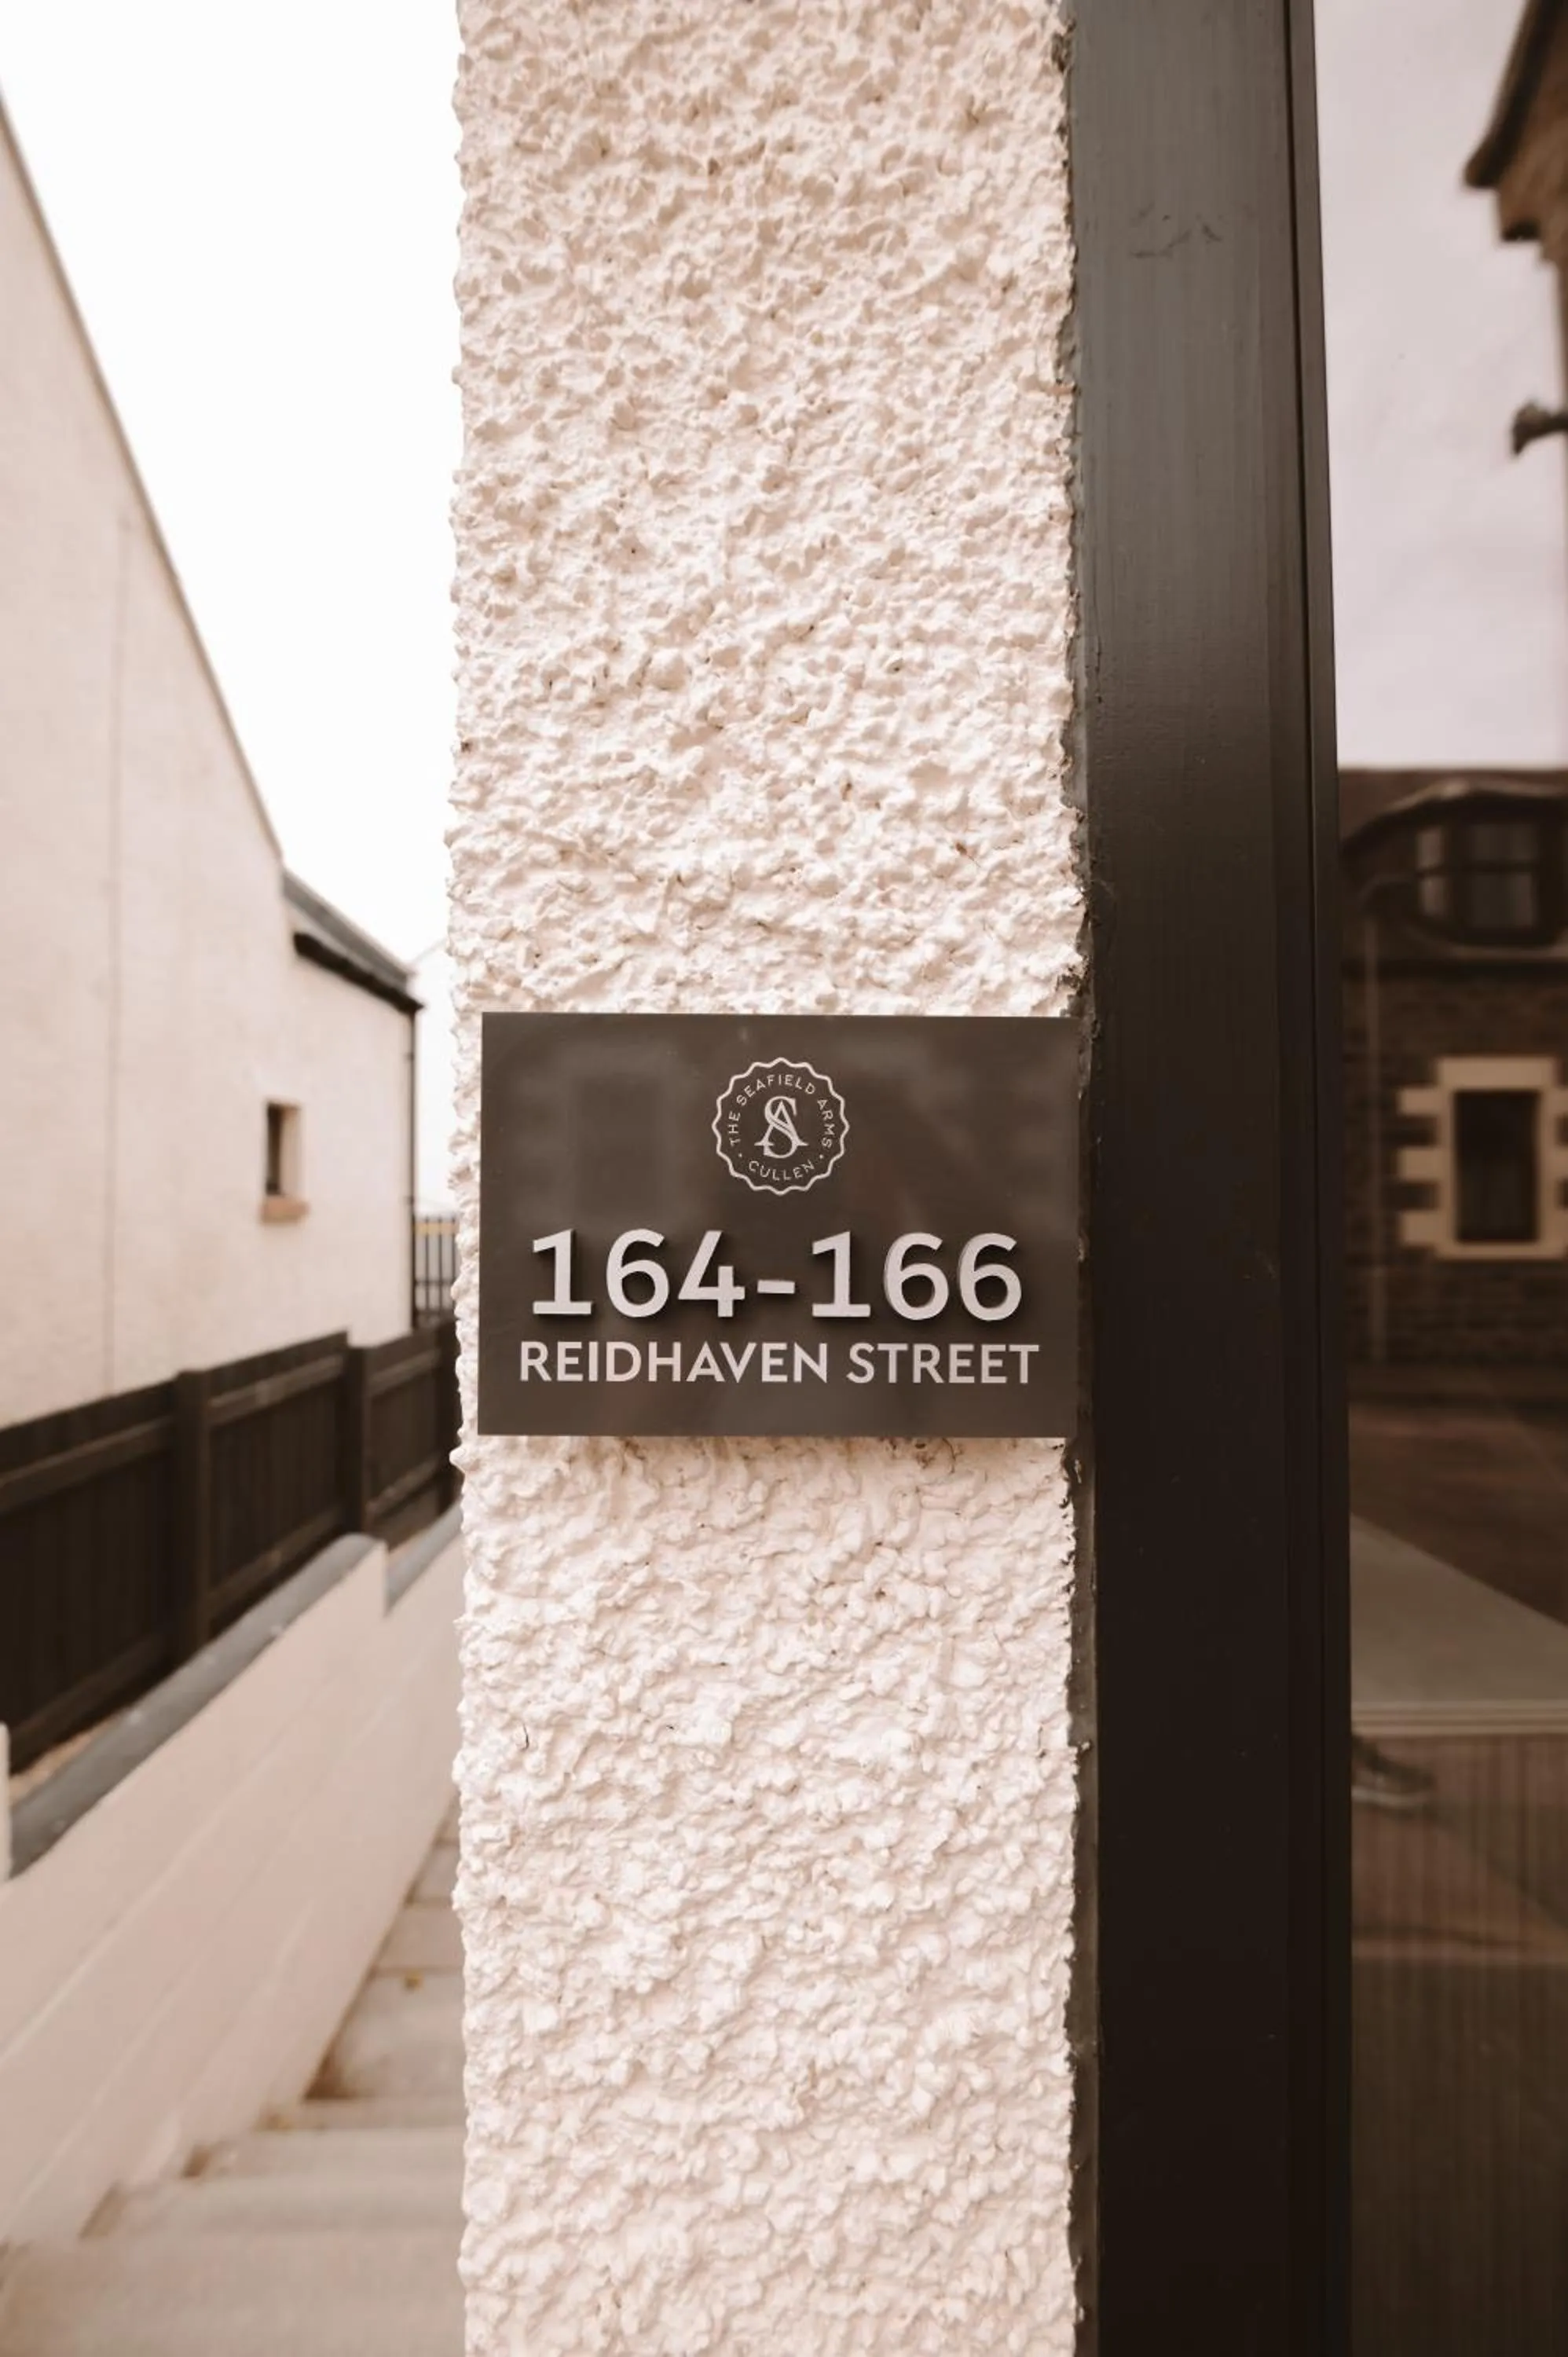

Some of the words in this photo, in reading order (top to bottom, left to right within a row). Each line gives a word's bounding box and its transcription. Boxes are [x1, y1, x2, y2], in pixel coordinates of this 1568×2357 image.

[727, 1111, 741, 1147] THE
[736, 1073, 817, 1106] SEAFIELD
[817, 1098, 836, 1149] ARMS
[749, 1158, 815, 1181] CULLEN
[532, 1229, 1021, 1321] 164-166
[519, 1340, 828, 1384] REIDHAVEN
[846, 1343, 1040, 1384] STREET
